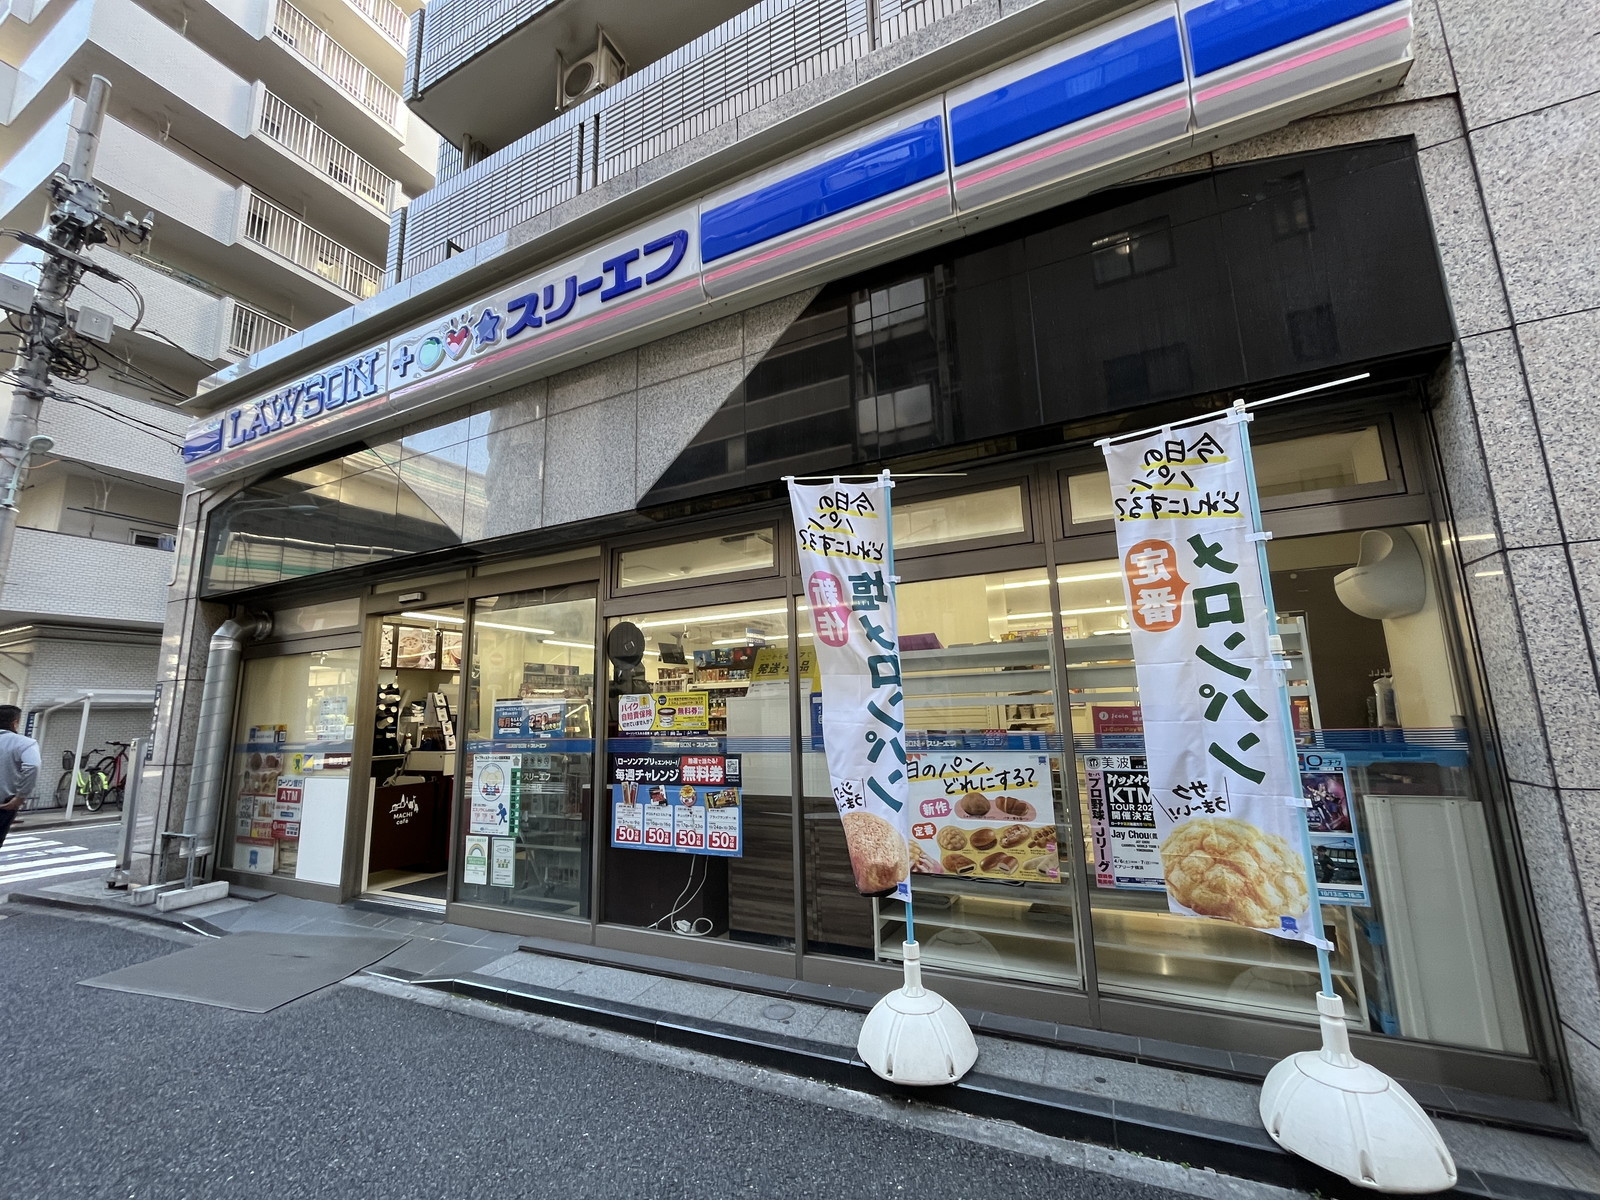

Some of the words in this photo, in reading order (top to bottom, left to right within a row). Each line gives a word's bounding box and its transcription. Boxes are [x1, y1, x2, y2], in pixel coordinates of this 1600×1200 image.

[228, 348, 380, 448] LAWSON
[506, 229, 689, 340] スリーエフ
[621, 702, 639, 712] バイク
[678, 706, 698, 716] 無料券
[621, 708, 653, 722] 自賠責保険
[1102, 756, 1130, 769] 美波
[616, 768, 680, 782] 毎週チャレンジ
[682, 765, 724, 783] 無料券
[943, 767, 1035, 795] どれにする?
[280, 790, 298, 801] ATM
[922, 801, 948, 815] 新作
[1110, 803, 1135, 811] TOUR
[393, 811, 413, 820] MACHI
[1111, 811, 1153, 821] 開催決定
[913, 826, 934, 837] 定番
[1111, 830, 1126, 840] Jay
